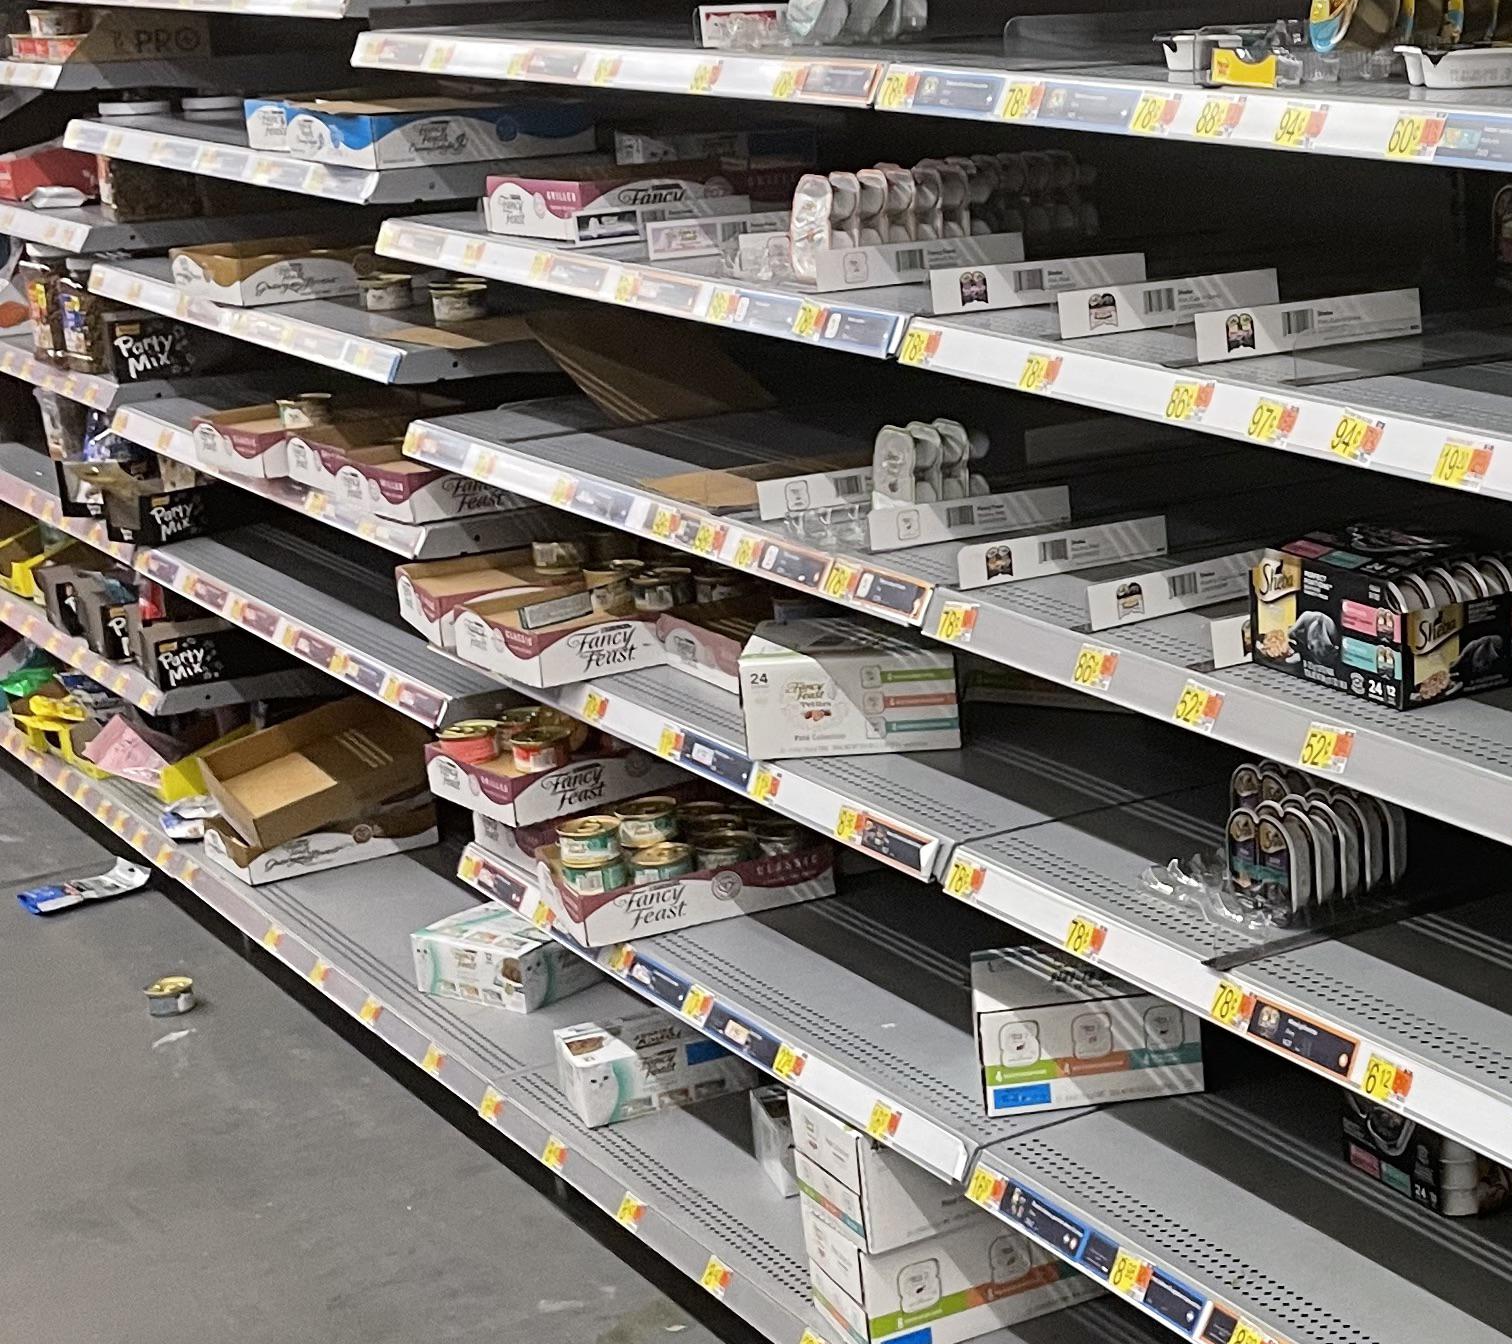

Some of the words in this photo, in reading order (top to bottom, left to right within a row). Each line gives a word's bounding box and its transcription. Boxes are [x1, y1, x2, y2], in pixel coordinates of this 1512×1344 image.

[1134, 98, 1160, 131] 78¢
[1196, 100, 1224, 135] 88¢
[1275, 109, 1305, 143] 94¢
[1388, 118, 1420, 154] 60¢
[617, 189, 687, 205] Fancy
[115, 330, 173, 359] Party
[128, 351, 173, 379] Mix
[1018, 358, 1045, 389] 78¢
[1167, 387, 1193, 419] 86¢
[1248, 404, 1277, 439] 97¢
[1331, 418, 1362, 452] 94¢
[160, 517, 191, 543] Mix
[939, 610, 961, 640] 78¢
[566, 628, 636, 651] Fancy
[158, 648, 205, 670] Party
[578, 648, 636, 672] Feast
[168, 662, 202, 687] Mix
[750, 673, 769, 686] 24
[1368, 679, 1383, 695] 24
[1175, 689, 1203, 723] 52¢
[1301, 732, 1331, 766] 52¢
[539, 765, 604, 793] Fancy
[557, 782, 606, 810] Feast
[618, 887, 686, 914] Fancy
[631, 902, 688, 925] Feast
[1067, 919, 1089, 952] 78¢
[1212, 983, 1238, 1019] 78¢
[1414, 1183, 1427, 1198] 24
